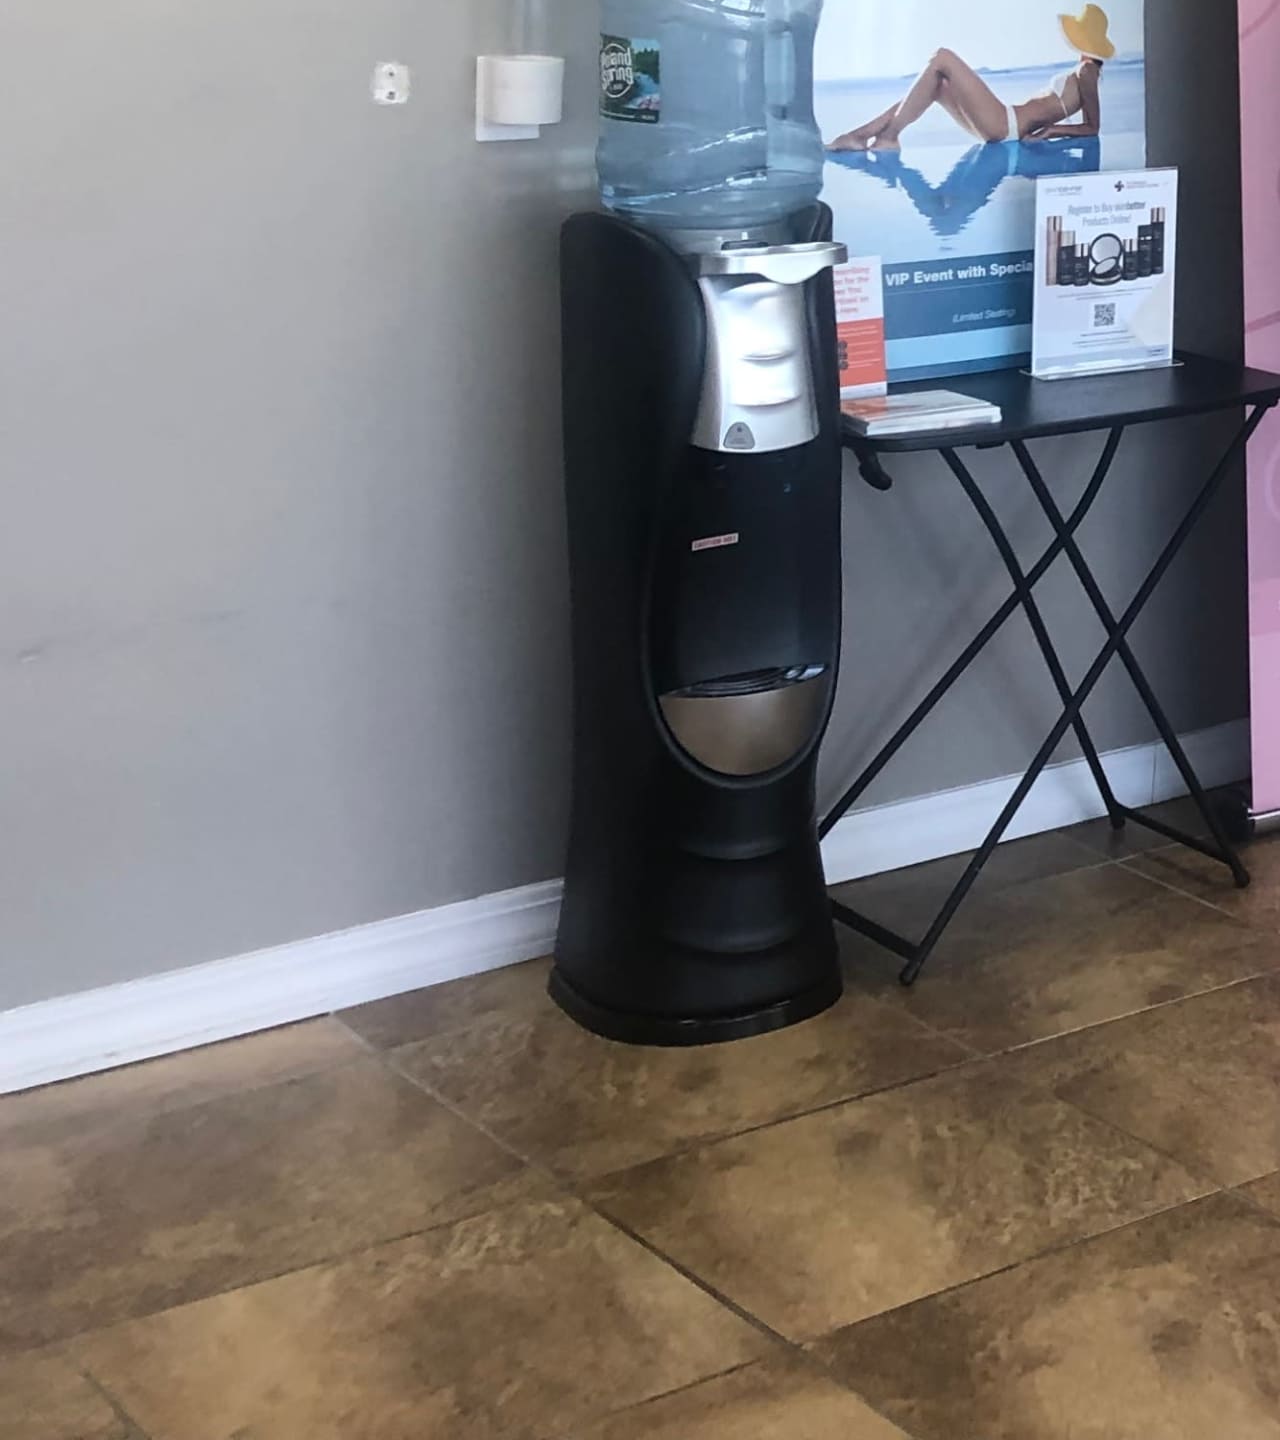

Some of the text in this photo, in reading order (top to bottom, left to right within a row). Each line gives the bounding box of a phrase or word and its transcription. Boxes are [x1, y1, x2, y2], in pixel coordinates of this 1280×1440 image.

[885, 272, 910, 287] VIP
[913, 269, 954, 284] Event
[957, 265, 987, 280] with
